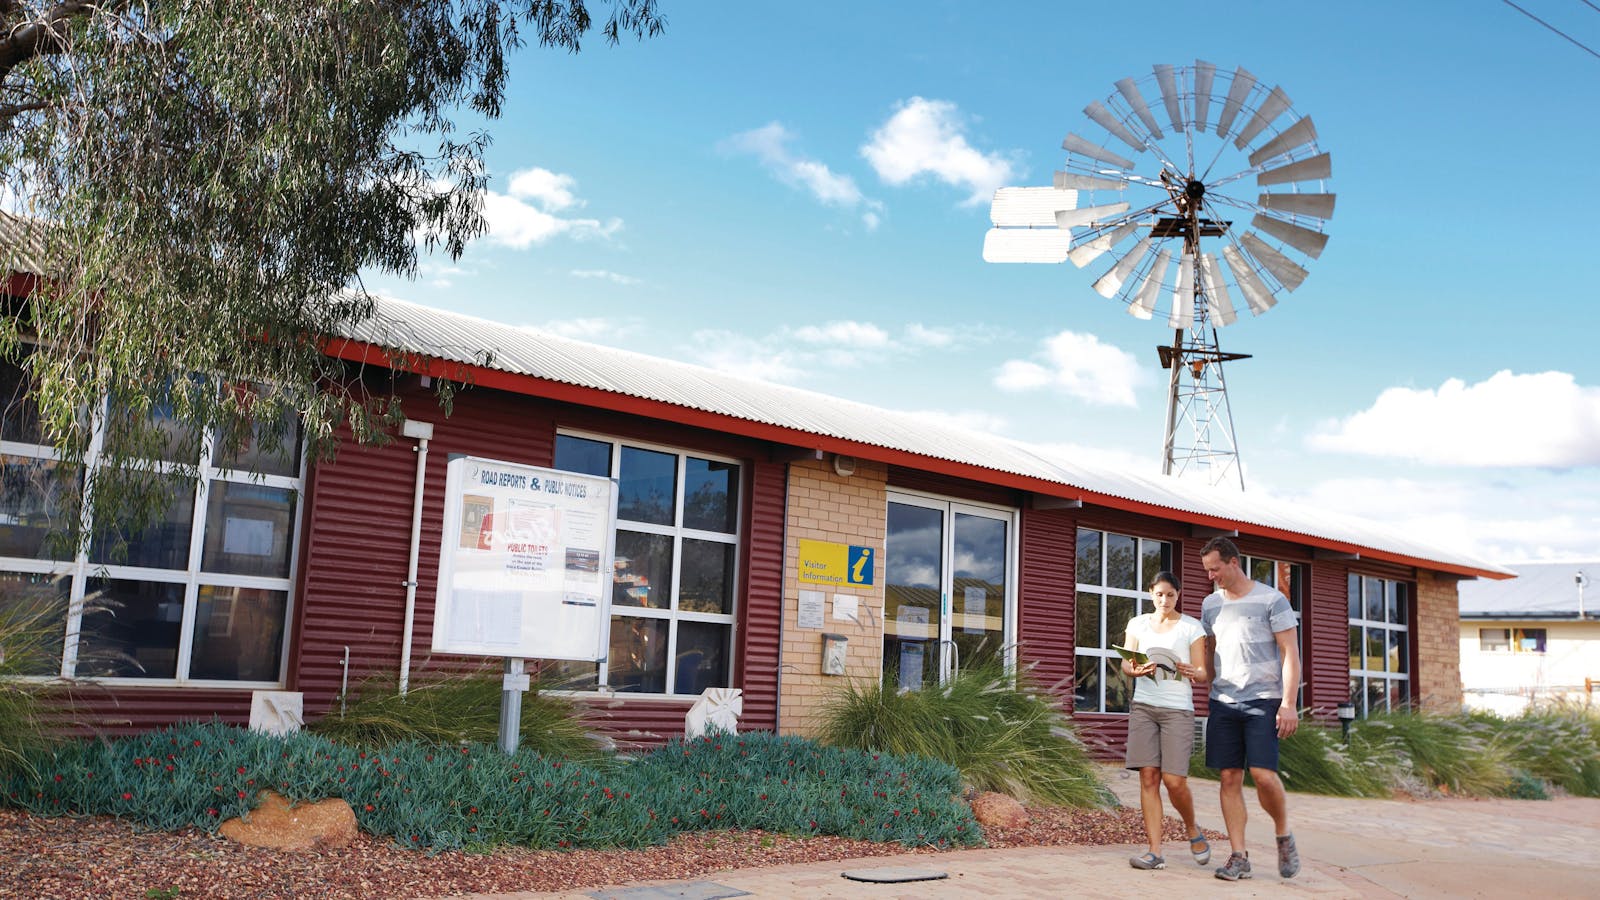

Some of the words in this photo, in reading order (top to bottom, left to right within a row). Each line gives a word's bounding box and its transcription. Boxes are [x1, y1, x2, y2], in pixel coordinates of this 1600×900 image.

[481, 470, 498, 485] ROAD
[499, 472, 527, 489] REPORTS
[530, 477, 541, 491] &
[545, 480, 564, 495] PUBLIC
[564, 482, 587, 498] NOTICES
[507, 543, 526, 552] PUBLIC
[804, 560, 827, 569] Visitor
[803, 571, 843, 583] Information
